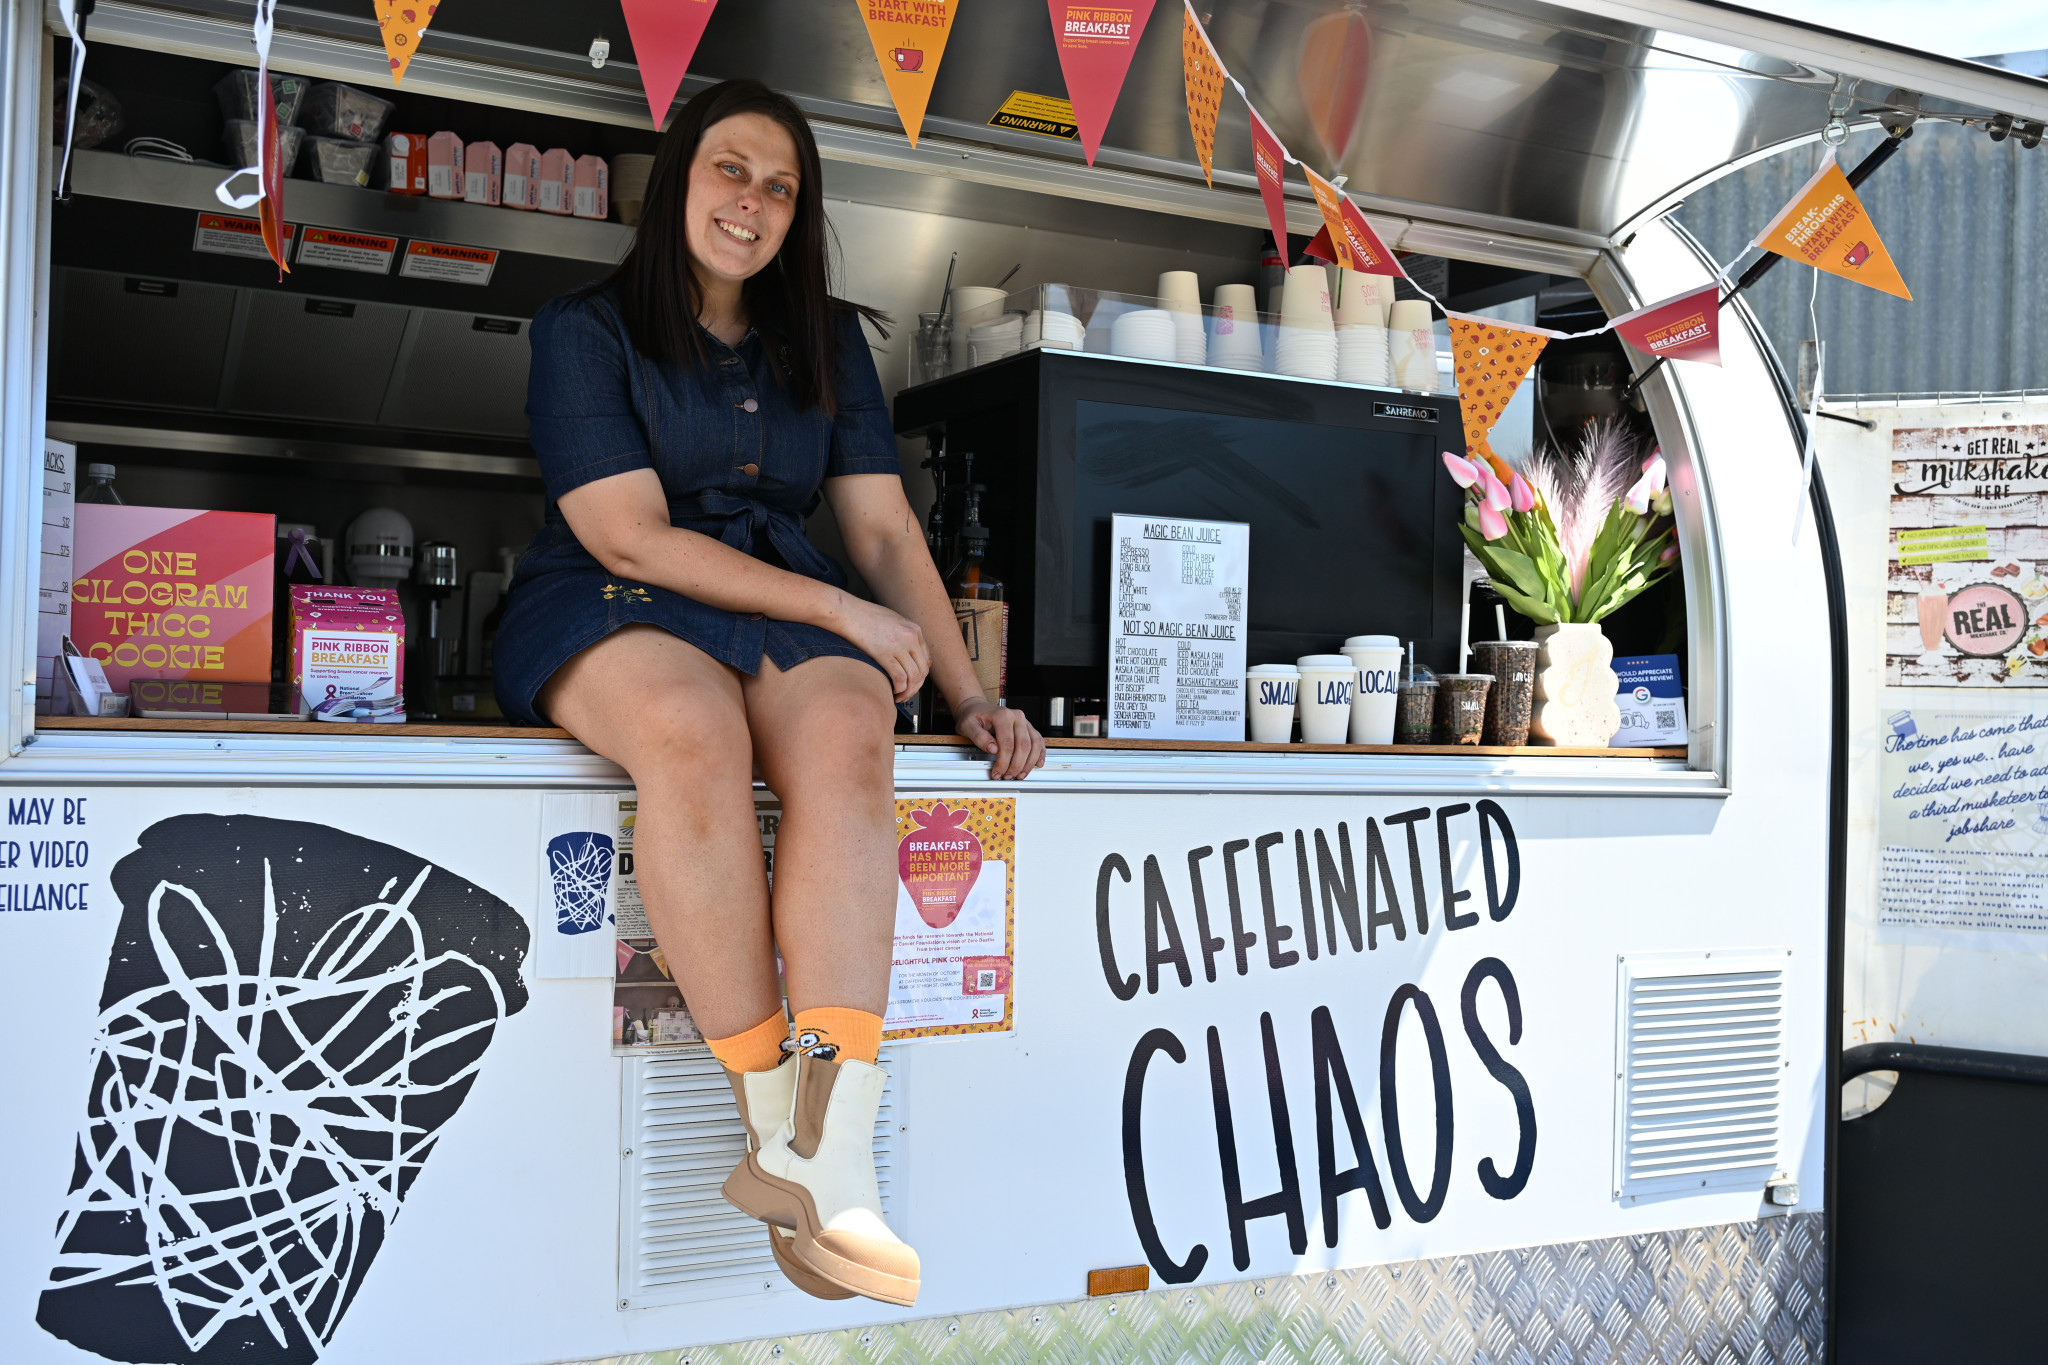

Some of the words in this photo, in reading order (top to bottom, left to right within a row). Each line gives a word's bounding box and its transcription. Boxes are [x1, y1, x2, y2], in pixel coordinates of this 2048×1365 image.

[913, 2, 946, 15] WITH
[869, 9, 947, 28] BREAKFAST
[1067, 10, 1091, 21] PINK
[1094, 12, 1132, 23] RIBBON
[1065, 21, 1131, 35] BREAKFAST
[999, 115, 1057, 133] WARNING
[1785, 207, 1819, 242] BREAK-
[1792, 194, 1845, 248] THROUGHS
[1801, 225, 1829, 254] START
[1828, 200, 1853, 225] WITH
[1808, 206, 1859, 261] BREAKFAST
[328, 233, 388, 249] WARNING
[432, 246, 489, 262] WARNING
[1646, 330, 1669, 343] PINK
[1670, 315, 1705, 335] RIBBON
[1650, 323, 1707, 350] BREAKFAST
[1385, 405, 1427, 419] SANREMO
[1967, 438, 1988, 456] GET
[1992, 437, 2020, 455] REAL
[1975, 485, 2010, 500] HERE
[1143, 524, 1168, 538] MAGIC
[1171, 526, 1193, 540] BEAN
[1197, 528, 1221, 542] JUICE
[1120, 537, 1131, 546] HOT
[1120, 547, 1149, 555] ESPRESSO
[123, 550, 197, 576] ONE
[1120, 555, 1149, 564] RISTRETTO
[1120, 563, 1133, 571] LONG
[1135, 564, 1151, 572] BLACK
[1195, 570, 1214, 578] COFFEE
[304, 591, 353, 599] THANK
[357, 594, 386, 602] YOU
[1120, 586, 1131, 594] FLAT
[1133, 587, 1148, 595] WHITE
[1119, 594, 1134, 602] LATTE
[1119, 602, 1151, 611] CAPPUCCINO
[1119, 610, 1136, 618] MOCHA
[1953, 604, 2016, 635] REAL
[105, 611, 211, 638] THICC
[1123, 620, 1141, 634] NOT
[1144, 621, 1156, 634] SO
[1159, 622, 1183, 636] MAGIC
[1186, 623, 1208, 637] BEAN
[1211, 625, 1235, 638] JUICE
[312, 642, 340, 652] PINK
[344, 643, 389, 653] RIBBON
[1116, 638, 1126, 646] HOT
[1177, 641, 1191, 649] COLD
[89, 642, 225, 670] COOKIE
[1116, 647, 1126, 655] HOT
[1128, 648, 1158, 657] CHOCOLATE
[1178, 651, 1189, 659] ICED
[1190, 651, 1211, 660] MASALA
[1212, 652, 1224, 660] CHAI
[311, 653, 389, 664] BREAKFAST
[1115, 656, 1129, 665] WHITE
[1130, 657, 1140, 665] HOT
[1141, 657, 1168, 667] CHOCOLATE
[1177, 659, 1189, 667] ICED
[1190, 659, 1211, 668] MATCHA
[1212, 660, 1224, 668] CHAI
[1146, 667, 1160, 675] LATTE
[1177, 668, 1188, 676] ICED
[1190, 668, 1219, 677] CHOCOLATE
[1638, 668, 1673, 676] APPRECIATE
[1146, 676, 1160, 684] LATTE
[1512, 672, 1531, 683] LARGE
[1115, 684, 1125, 692] HOT
[1126, 684, 1145, 693] BISCOFF
[1176, 700, 1188, 709] ICED
[1189, 700, 1199, 709] TEA
[1461, 701, 1479, 710] SMALL
[1885, 733, 1914, 753] The
[1917, 734, 1949, 749] time
[1950, 726, 1977, 743] has
[1979, 723, 2016, 738] come
[2018, 714, 2048, 731] that
[1908, 761, 1934, 773] we,
[1937, 756, 1961, 774] yes
[1998, 742, 2035, 758] have
[1893, 776, 1951, 799] decided
[1951, 778, 1973, 790] we
[1974, 765, 2013, 786] need
[2014, 767, 2028, 779] to
[1921, 797, 1961, 818] third
[1961, 791, 2037, 811] musketeer
[8, 798, 54, 825] MAY
[63, 798, 87, 825] BE
[909, 841, 971, 851] BREAKFAST
[30, 841, 89, 868] VIDEO
[909, 852, 932, 862] HAS
[935, 851, 971, 861] NEVER
[909, 862, 936, 872] BEEN
[940, 862, 971, 871] MORE
[909, 872, 971, 882] IMPORTANT
[1096, 799, 1521, 1001] CAFFEINATED
[1122, 956, 1538, 1284] CHAOS
